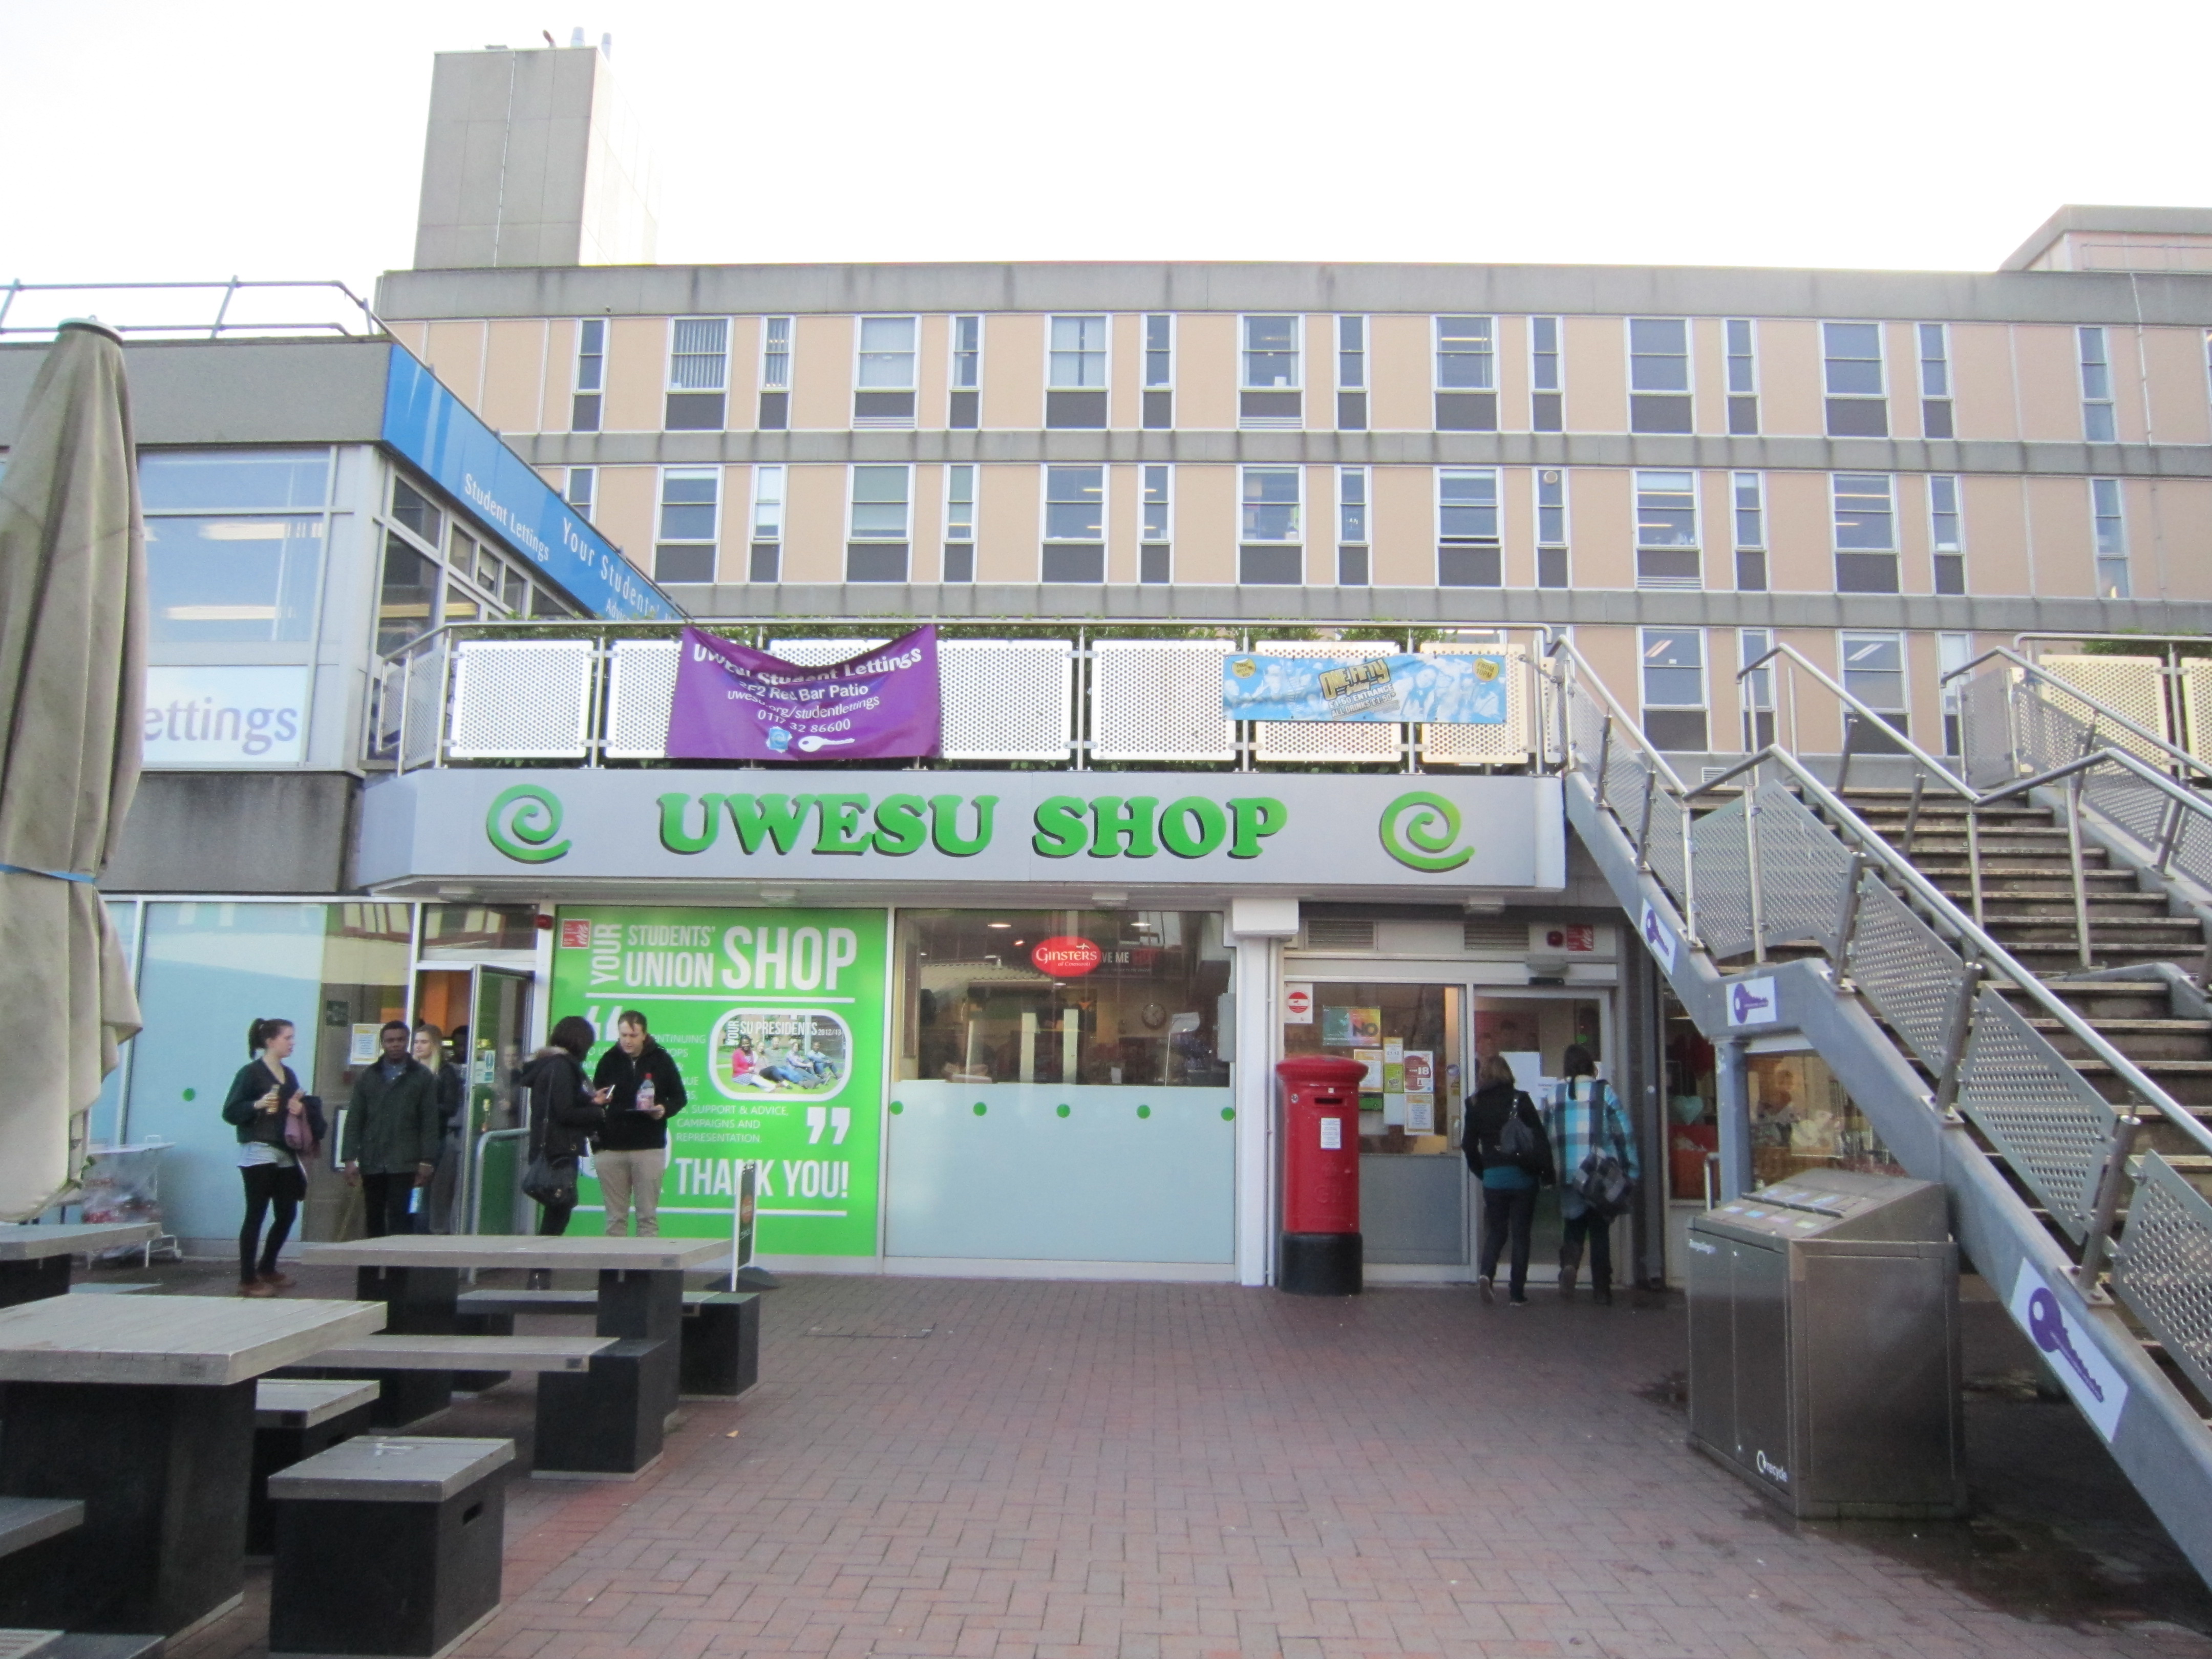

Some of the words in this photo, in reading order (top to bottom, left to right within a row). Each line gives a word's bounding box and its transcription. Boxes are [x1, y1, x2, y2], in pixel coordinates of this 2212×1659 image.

[465, 473, 507, 526] Student
[511, 513, 549, 562] Lettings
[563, 517, 595, 566] Your
[845, 648, 922, 676] Lettings
[1476, 668, 1492, 679] 10PM
[1477, 662, 1495, 672] FROM
[798, 689, 825, 702] Bar
[829, 684, 868, 698] Patio
[1320, 668, 1350, 700] ONE
[1328, 696, 1352, 709] £1.50
[1352, 683, 1394, 701] ENTRANCE
[1332, 708, 1345, 717] ALL
[1345, 700, 1371, 713] DRINKS
[144, 696, 298, 756] ettings
[758, 709, 786, 724] 0117
[790, 722, 806, 732] 32
[810, 718, 850, 733] 86600
[657, 792, 999, 858] UWESU
[1032, 795, 1287, 859] SHOP
[590, 924, 623, 985] YOUR
[721, 925, 857, 990] SHOP
[1116, 951, 1130, 963] ME
[625, 951, 714, 988] UNION
[650, 1034, 706, 1044] NTINUING
[726, 1020, 739, 1045] YOUR
[740, 1021, 753, 1034] SU
[756, 1021, 818, 1035] PRESIDENTS
[1352, 1022, 1378, 1037] NO
[1417, 1066, 1430, 1075] 18
[692, 1104, 736, 1114] SUPPORT
[739, 1105, 747, 1114] &
[751, 1105, 789, 1117] ADVICE,
[676, 1118, 735, 1128] CAMPAIGNS
[738, 1119, 760, 1129] AND
[676, 1133, 762, 1143] REPRESENTATION.
[784, 1159, 849, 1198] YOU!
